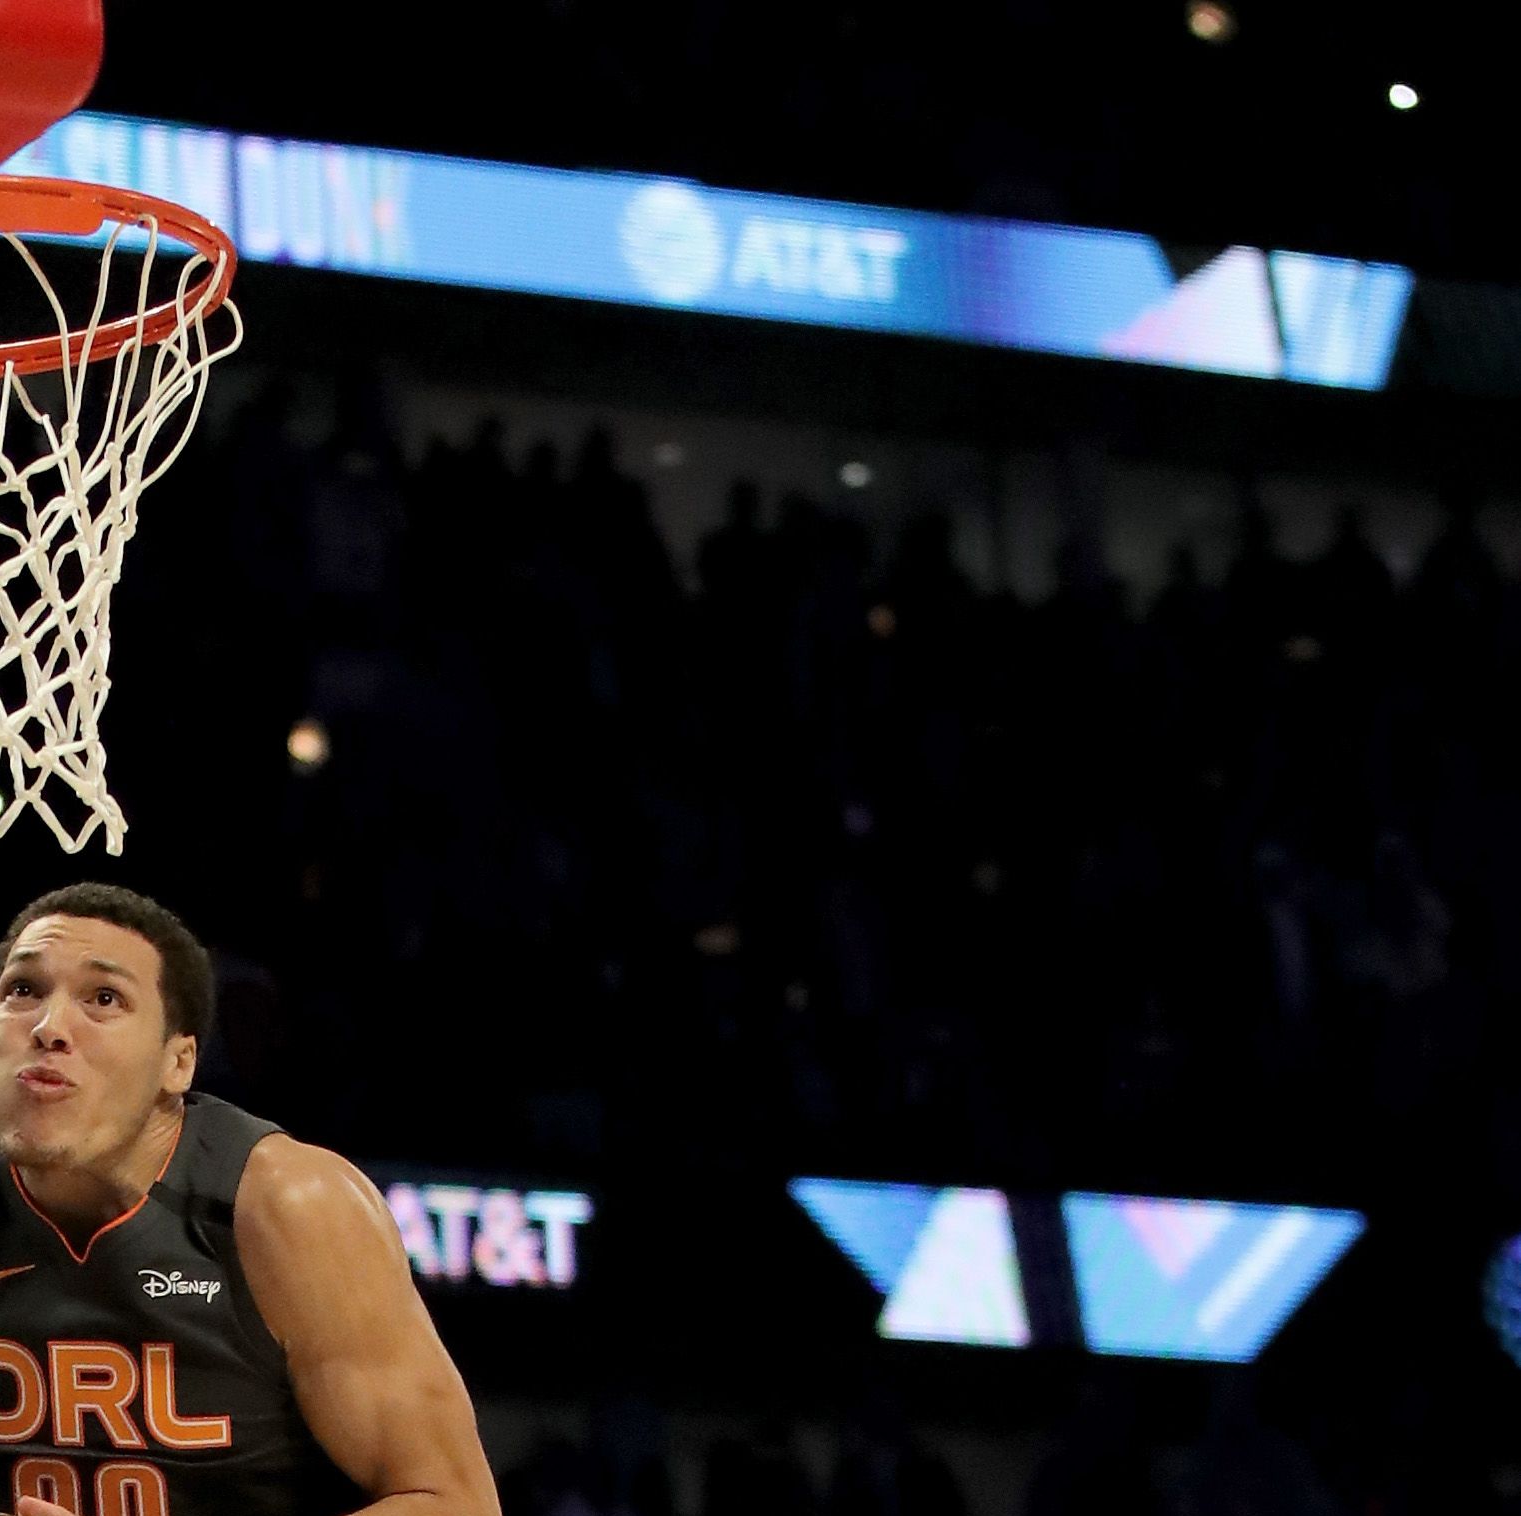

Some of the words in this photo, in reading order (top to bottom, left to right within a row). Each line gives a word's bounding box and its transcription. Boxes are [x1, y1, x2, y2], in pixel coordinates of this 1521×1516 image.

[733, 214, 906, 304] AT&T
[386, 1182, 593, 1288] AT&T
[137, 1269, 221, 1304] Disney
